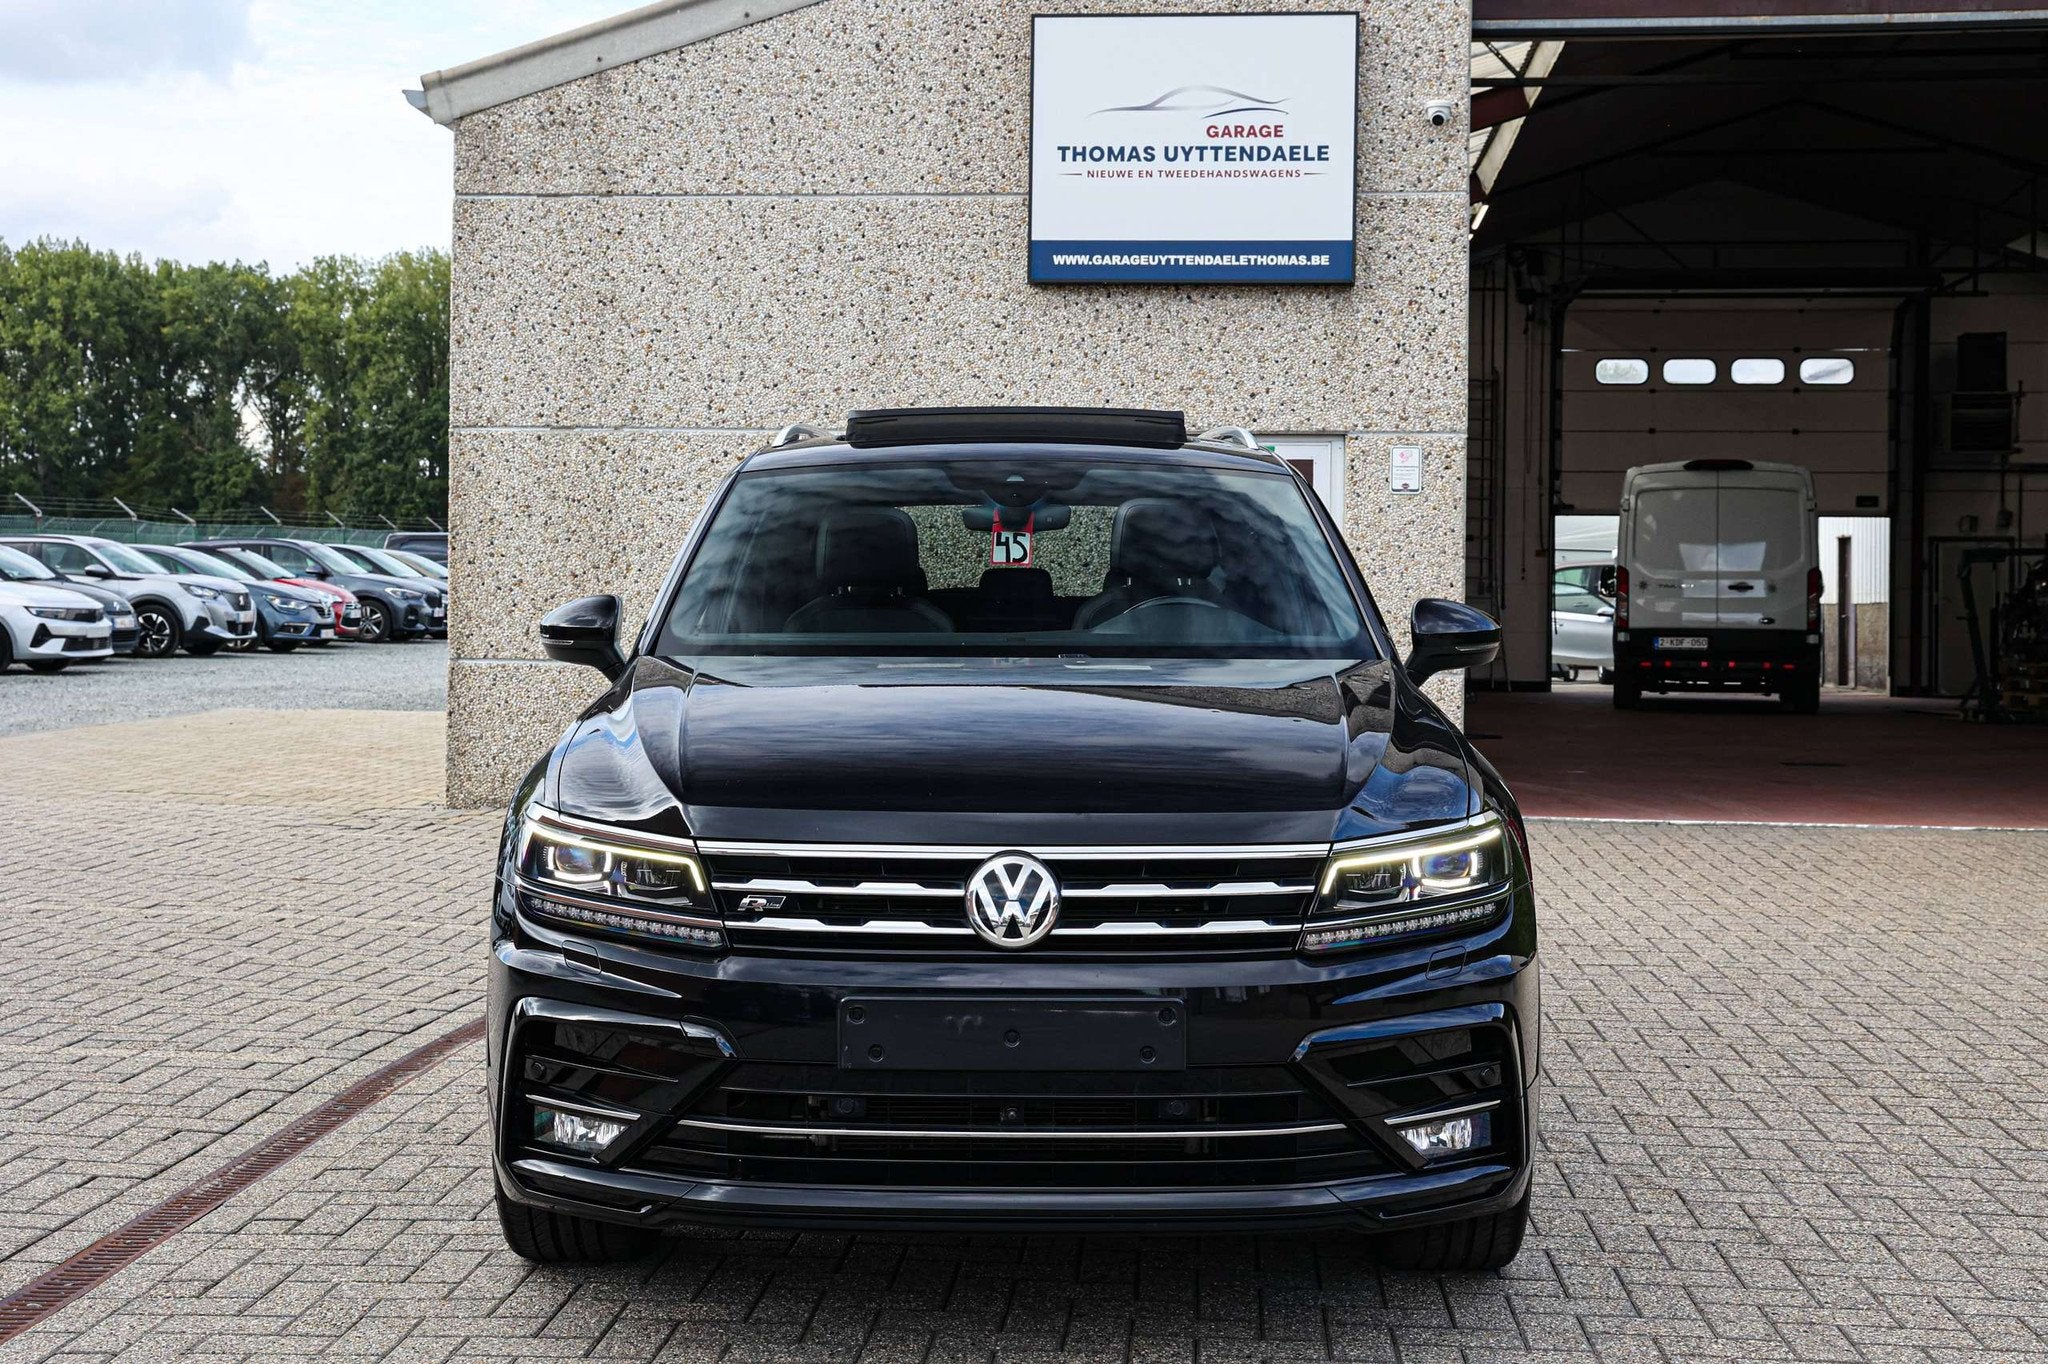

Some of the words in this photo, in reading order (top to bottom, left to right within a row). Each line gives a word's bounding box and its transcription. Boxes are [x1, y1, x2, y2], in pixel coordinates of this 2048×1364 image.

[1206, 125, 1284, 138] GARAGE
[1057, 145, 1156, 162] THOMAS
[1164, 145, 1330, 162] UYTTENDAELE
[1087, 169, 1134, 179] NIEUWE
[1138, 169, 1154, 179] EN
[1158, 169, 1302, 179] TWEEDEHANDSWAGENS
[1053, 254, 1330, 266] WWW.GARAGEUYTTENDAELETHOMAS.BE
[995, 532, 1029, 563] 45
